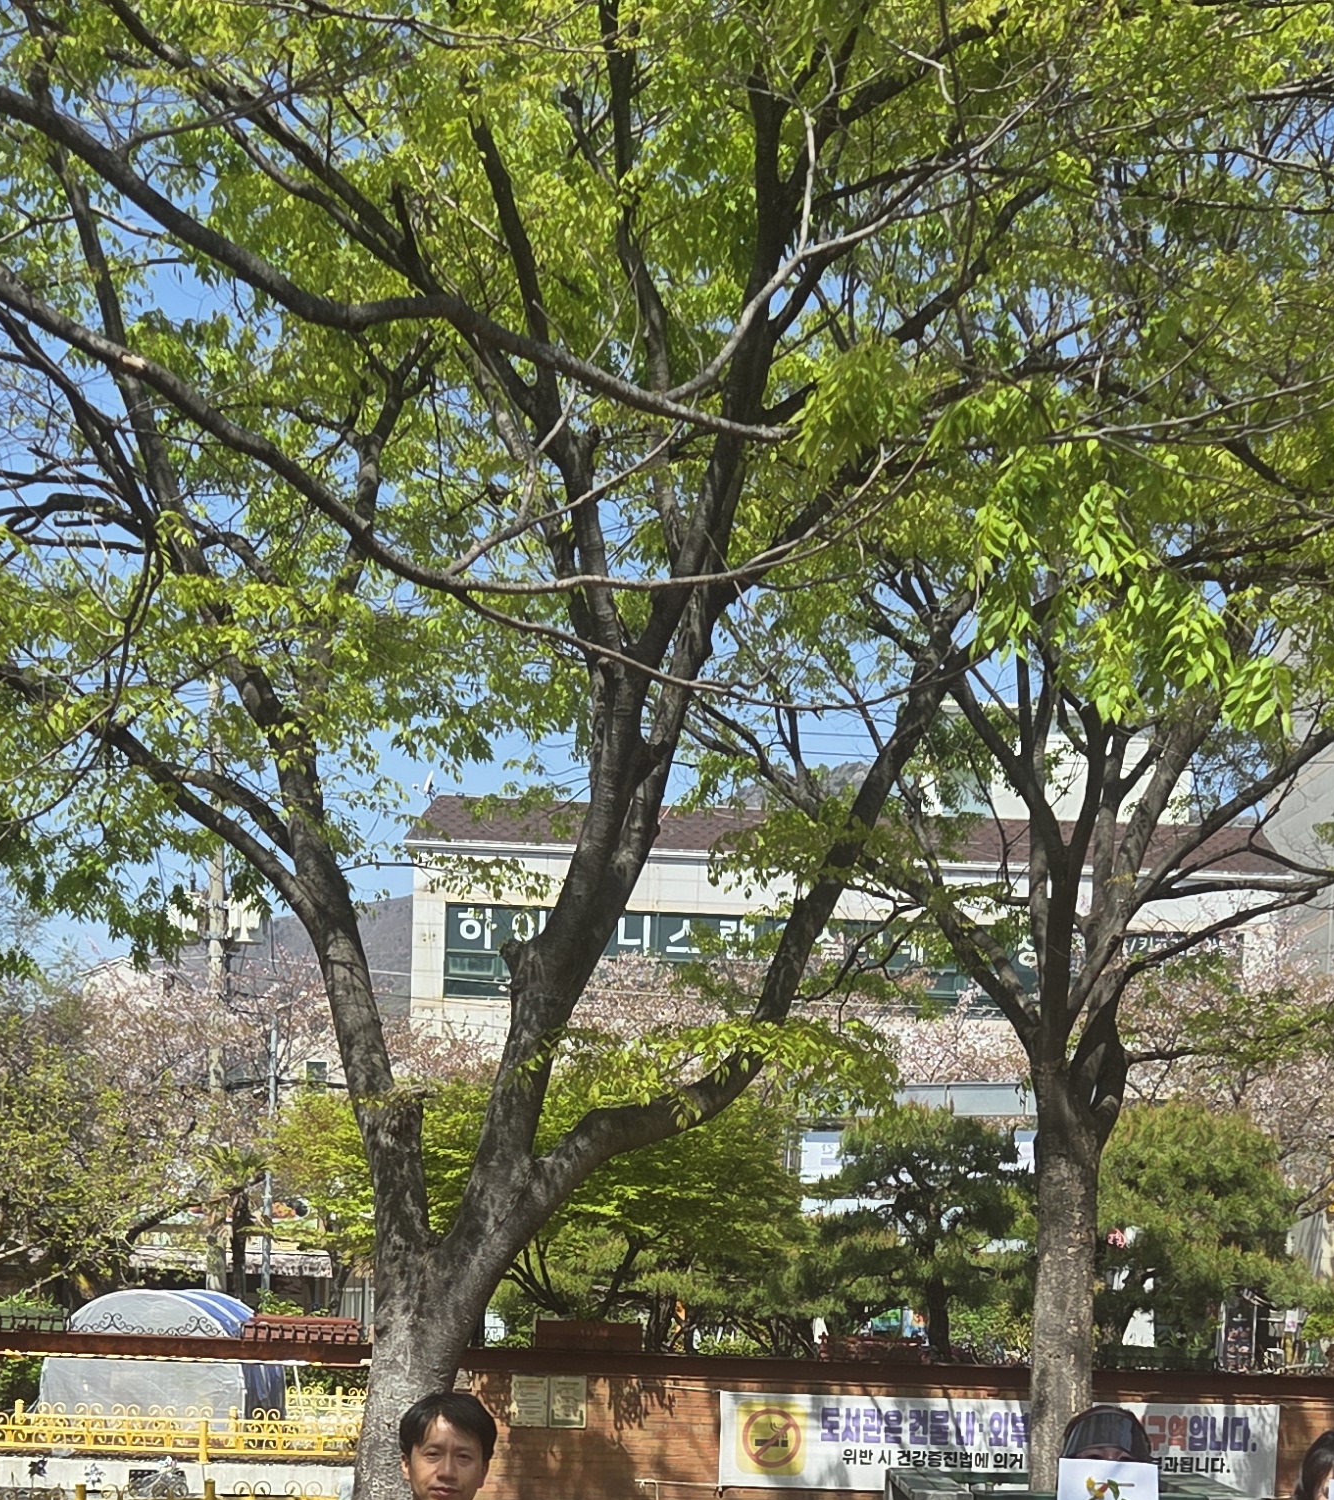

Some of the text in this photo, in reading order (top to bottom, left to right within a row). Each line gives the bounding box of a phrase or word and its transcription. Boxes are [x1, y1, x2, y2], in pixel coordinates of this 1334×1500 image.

[820, 1406, 903, 1445] 도서관은
[907, 1409, 950, 1446] 건물
[1141, 1414, 1258, 1453] 구역입니다.
[842, 1448, 1025, 1470] 위반 시 건강증진법에 의거
